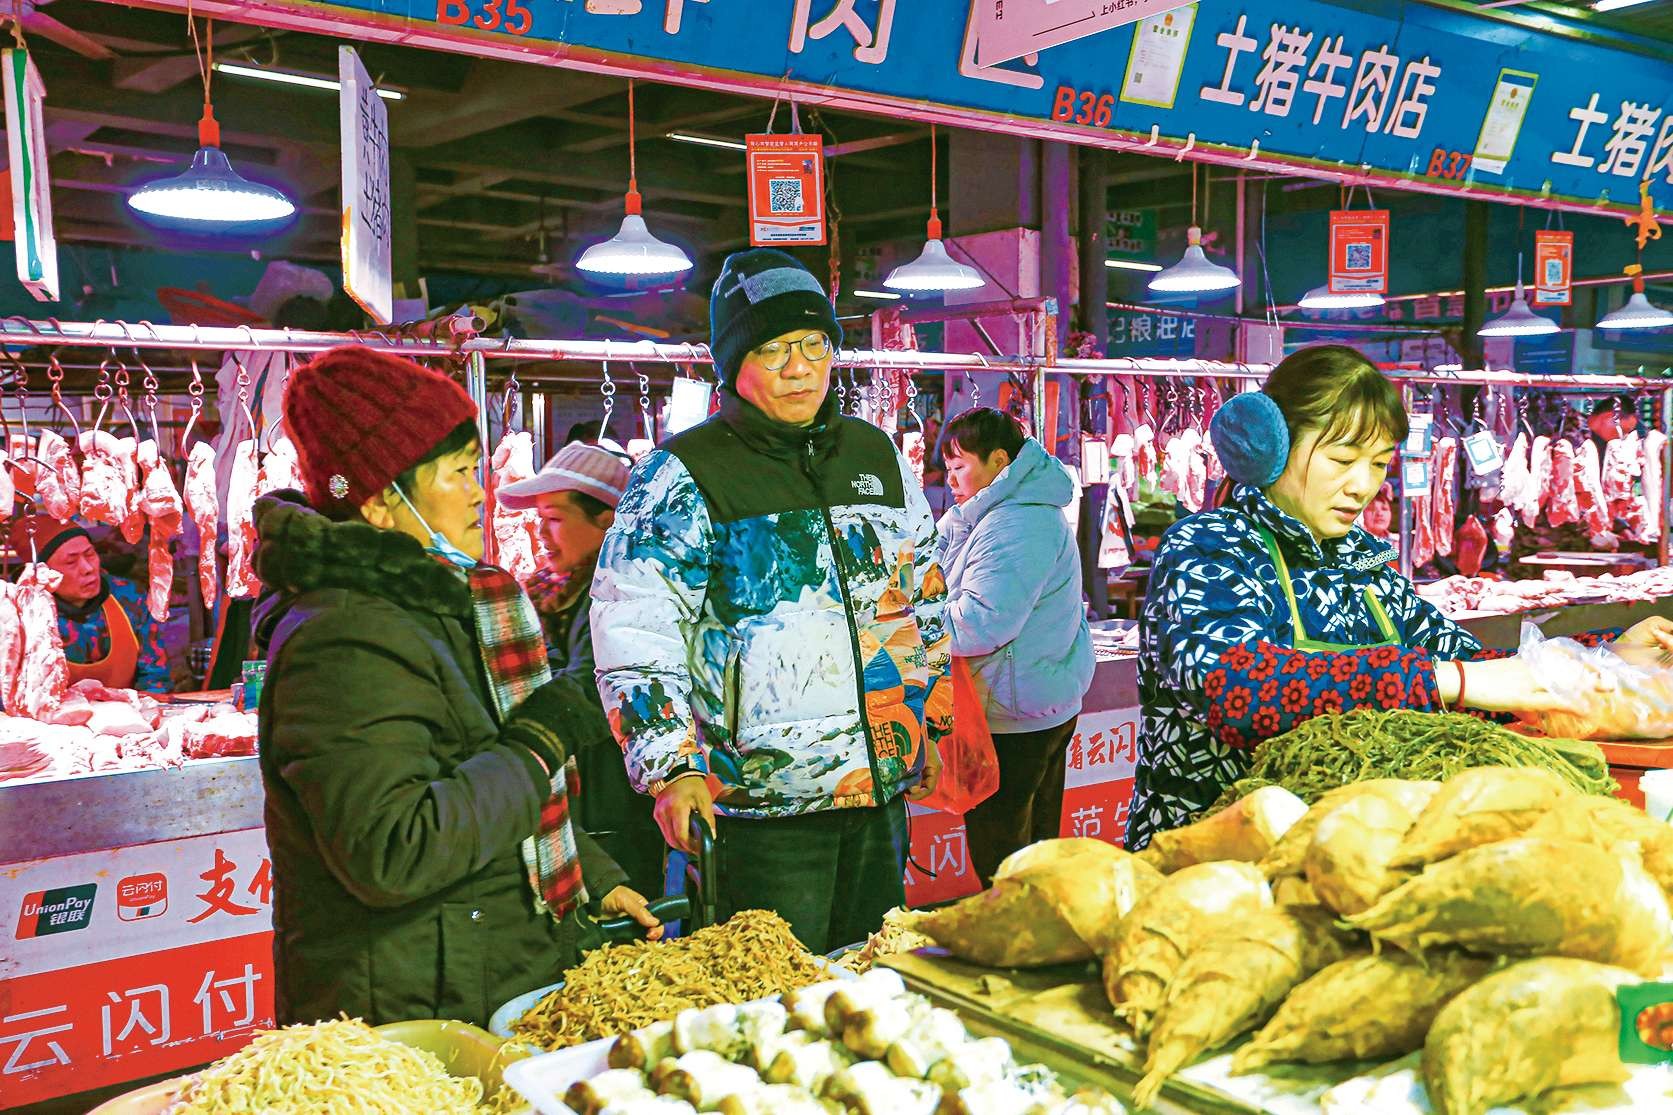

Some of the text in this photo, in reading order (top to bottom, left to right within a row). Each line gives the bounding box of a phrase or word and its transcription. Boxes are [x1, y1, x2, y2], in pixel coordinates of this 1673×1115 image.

[1200, 14, 1441, 140] 土猪牛肉店
[1051, 86, 1115, 128] B36
[1425, 148, 1473, 181] B37
[850, 480, 873, 488] NORTH
[858, 488, 874, 496] FACE
[121, 880, 163, 897] 云闪付
[23, 896, 92, 916] UnionPay
[50, 909, 85, 926] 银联
[0, 963, 263, 1075] 云闪付
